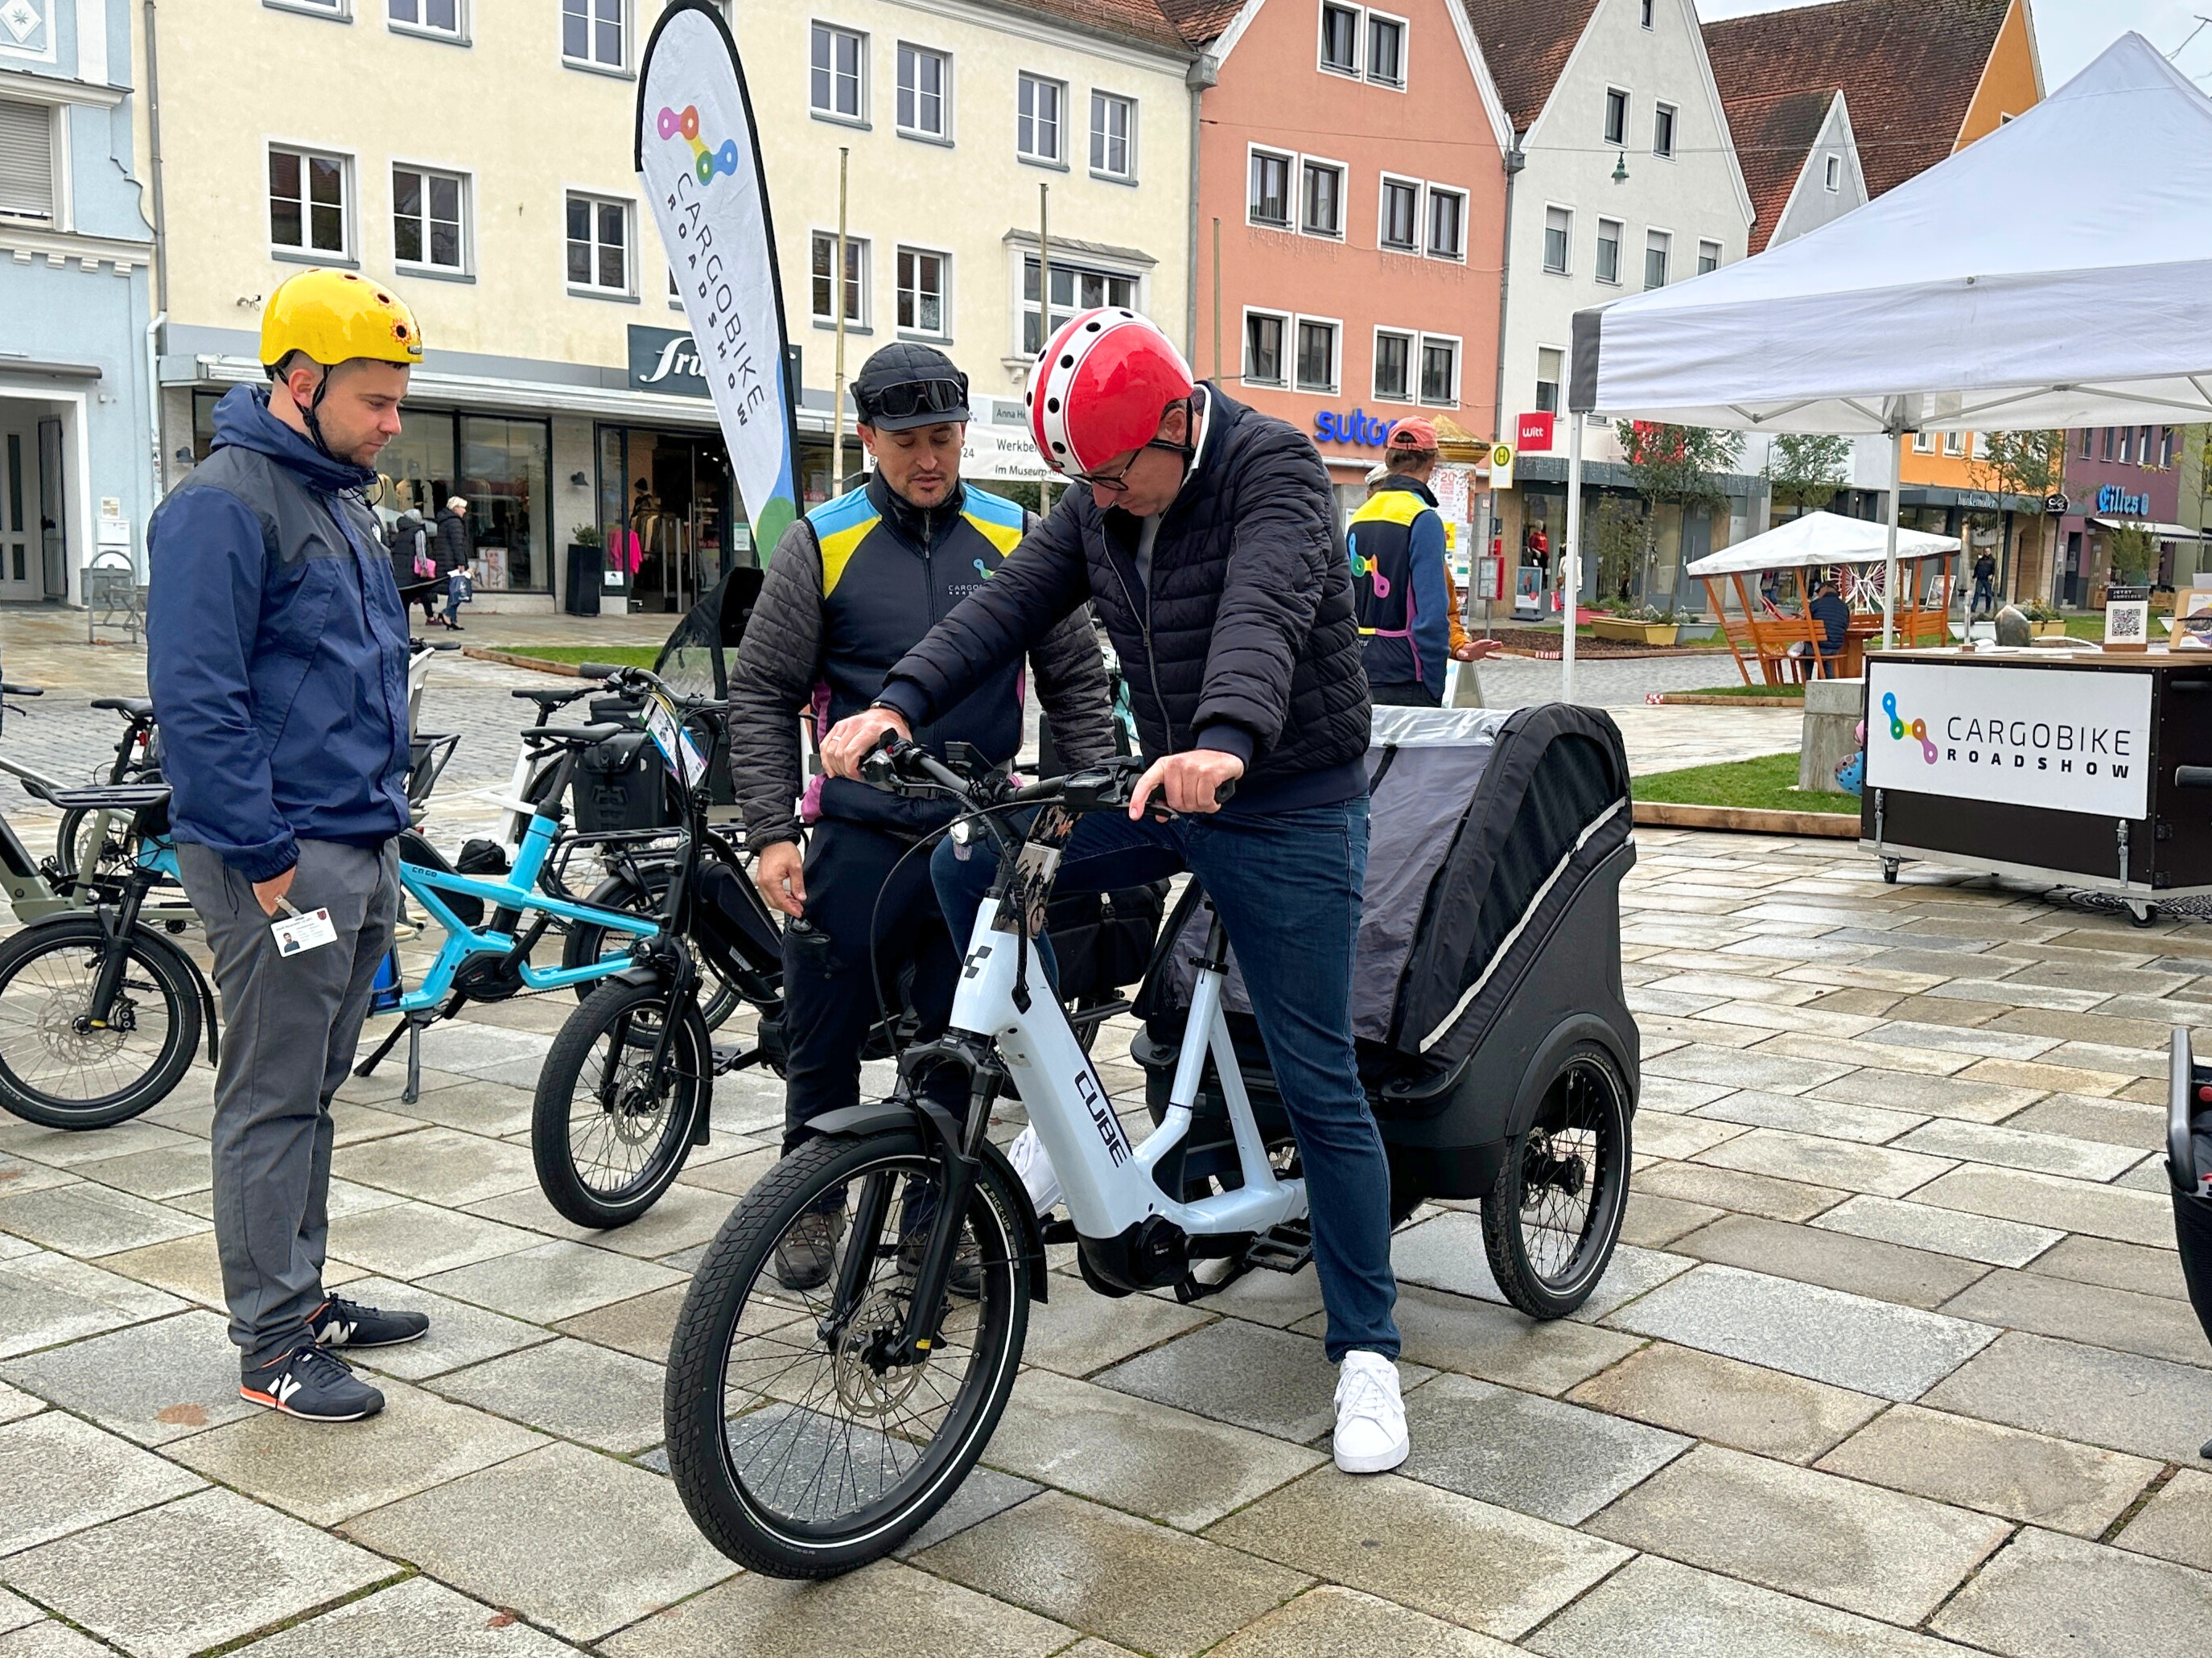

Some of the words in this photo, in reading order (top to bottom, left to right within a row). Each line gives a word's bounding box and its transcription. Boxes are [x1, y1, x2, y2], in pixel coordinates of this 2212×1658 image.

[677, 172, 764, 413] CARGOBIKE
[667, 193, 748, 426] ROADSHOW
[996, 408, 1015, 418] Anna
[1522, 426, 1544, 438] witt
[1008, 465, 1047, 476] Museum
[1440, 471, 1455, 483] 20
[1946, 716, 2131, 756] CARGOBIKE
[1946, 747, 2129, 779] ROADSHOW
[1074, 1070, 1127, 1168] CUBE
